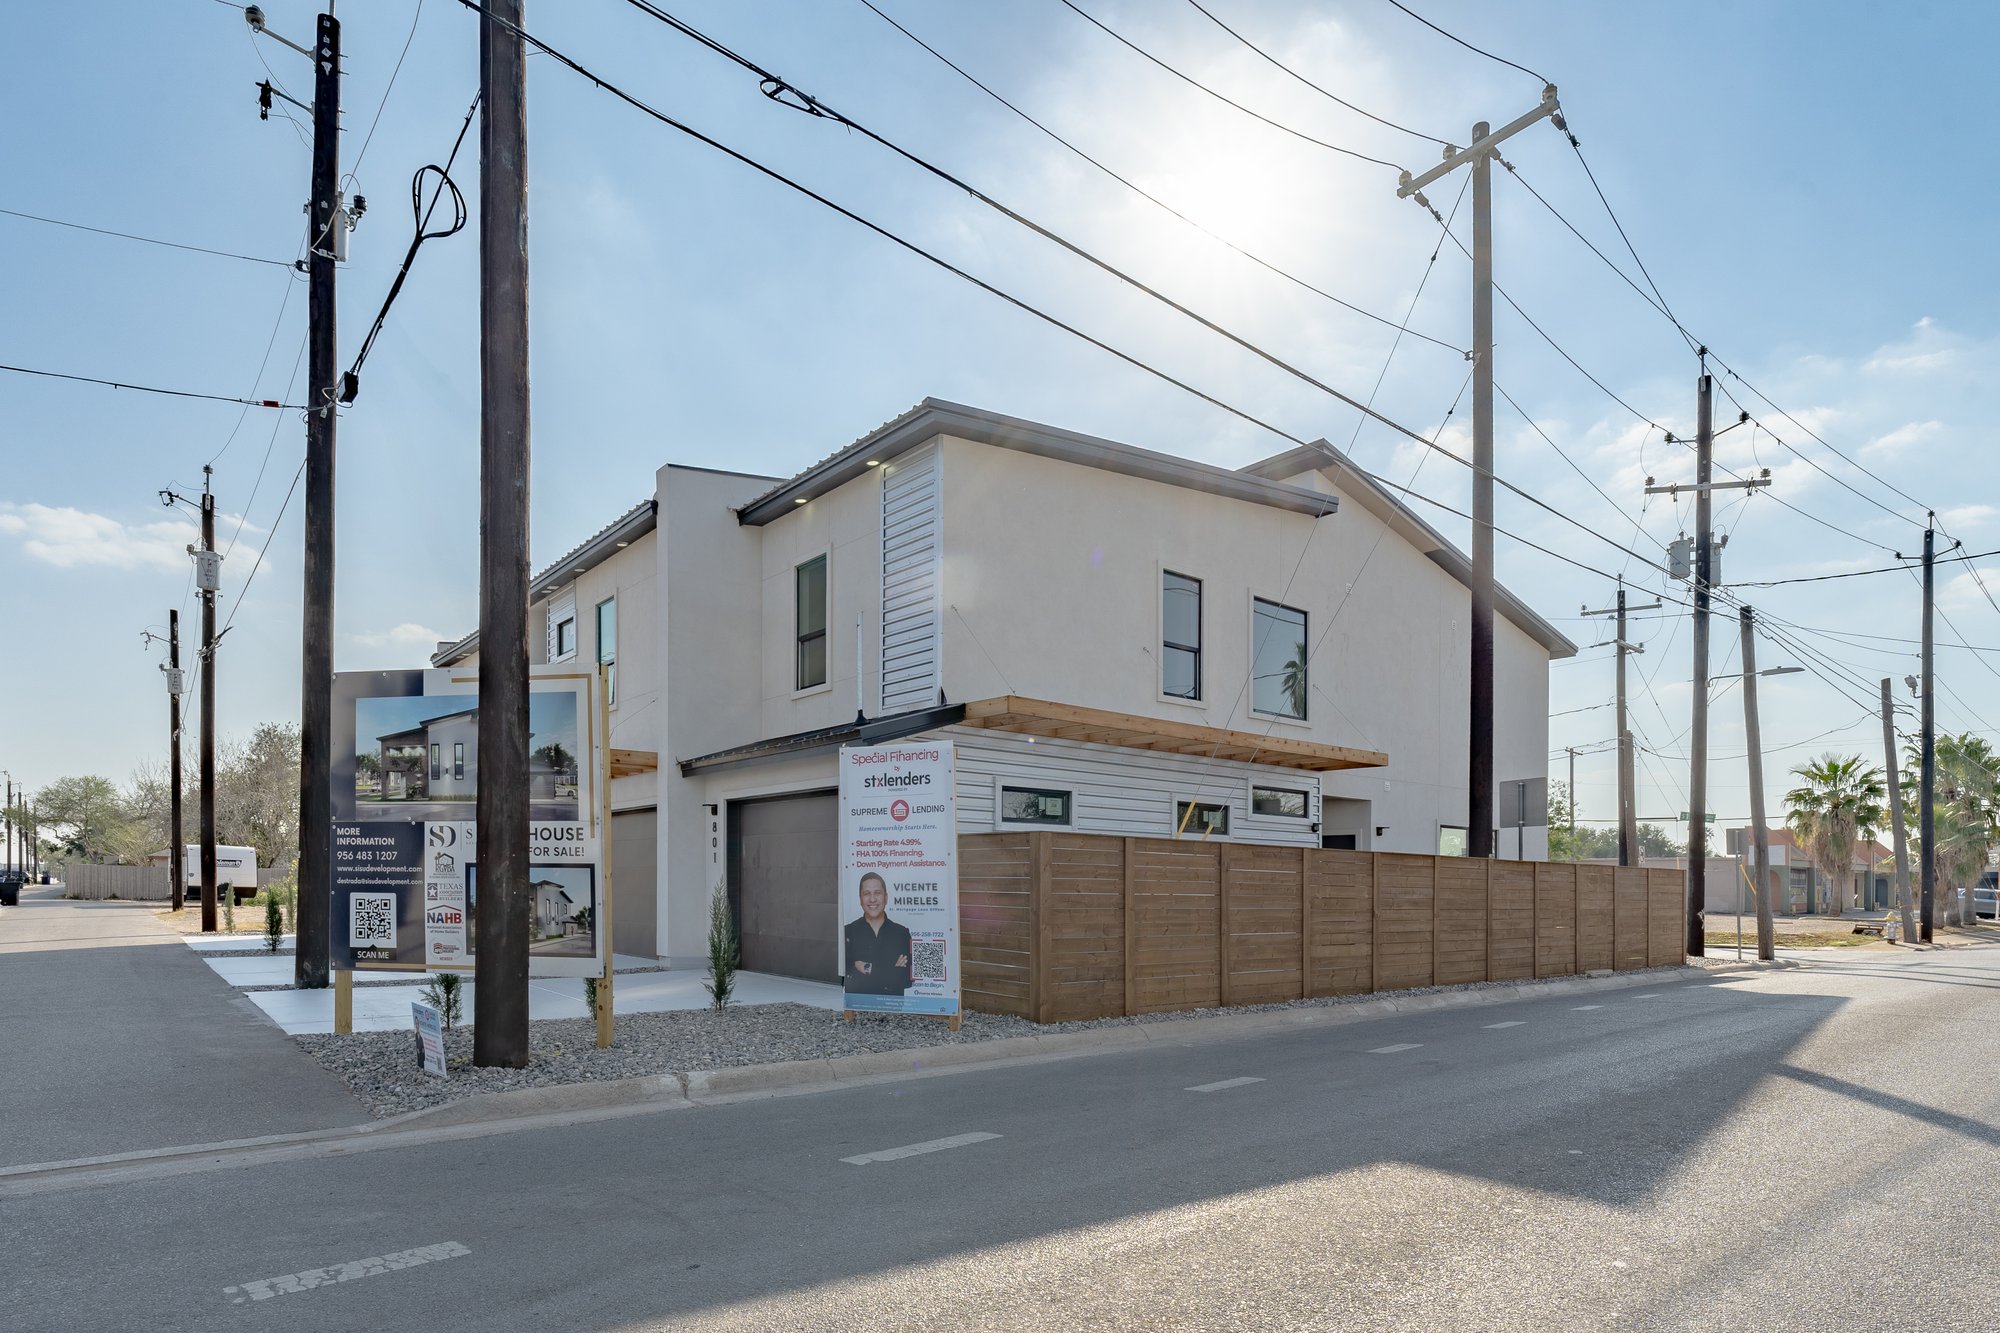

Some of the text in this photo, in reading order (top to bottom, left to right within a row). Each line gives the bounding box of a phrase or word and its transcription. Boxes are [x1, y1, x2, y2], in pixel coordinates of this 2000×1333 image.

[852, 748, 939, 766] Special Financing
[864, 771, 931, 788] stxlenders
[851, 804, 945, 817] SUPREME LENDING
[337, 828, 360, 836] MORE
[336, 837, 395, 846] INFORMATION
[855, 839, 882, 848] Starting
[337, 851, 398, 860] 956 483 1207
[553, 846, 584, 857] SALE!
[856, 850, 871, 858] FHA
[889, 849, 924, 858] Financing.
[877, 860, 908, 869] Payment
[909, 859, 947, 867] Assistance.
[337, 864, 423, 874] www.sisudevelopment.com
[336, 877, 423, 886] destrada@sisudevelopment.com
[439, 882, 464, 890] TEXAS
[893, 883, 938, 892] VICENTE
[894, 897, 939, 905] MIRELES
[427, 912, 462, 924] NAHB
[357, 950, 390, 959] SCAN ME
